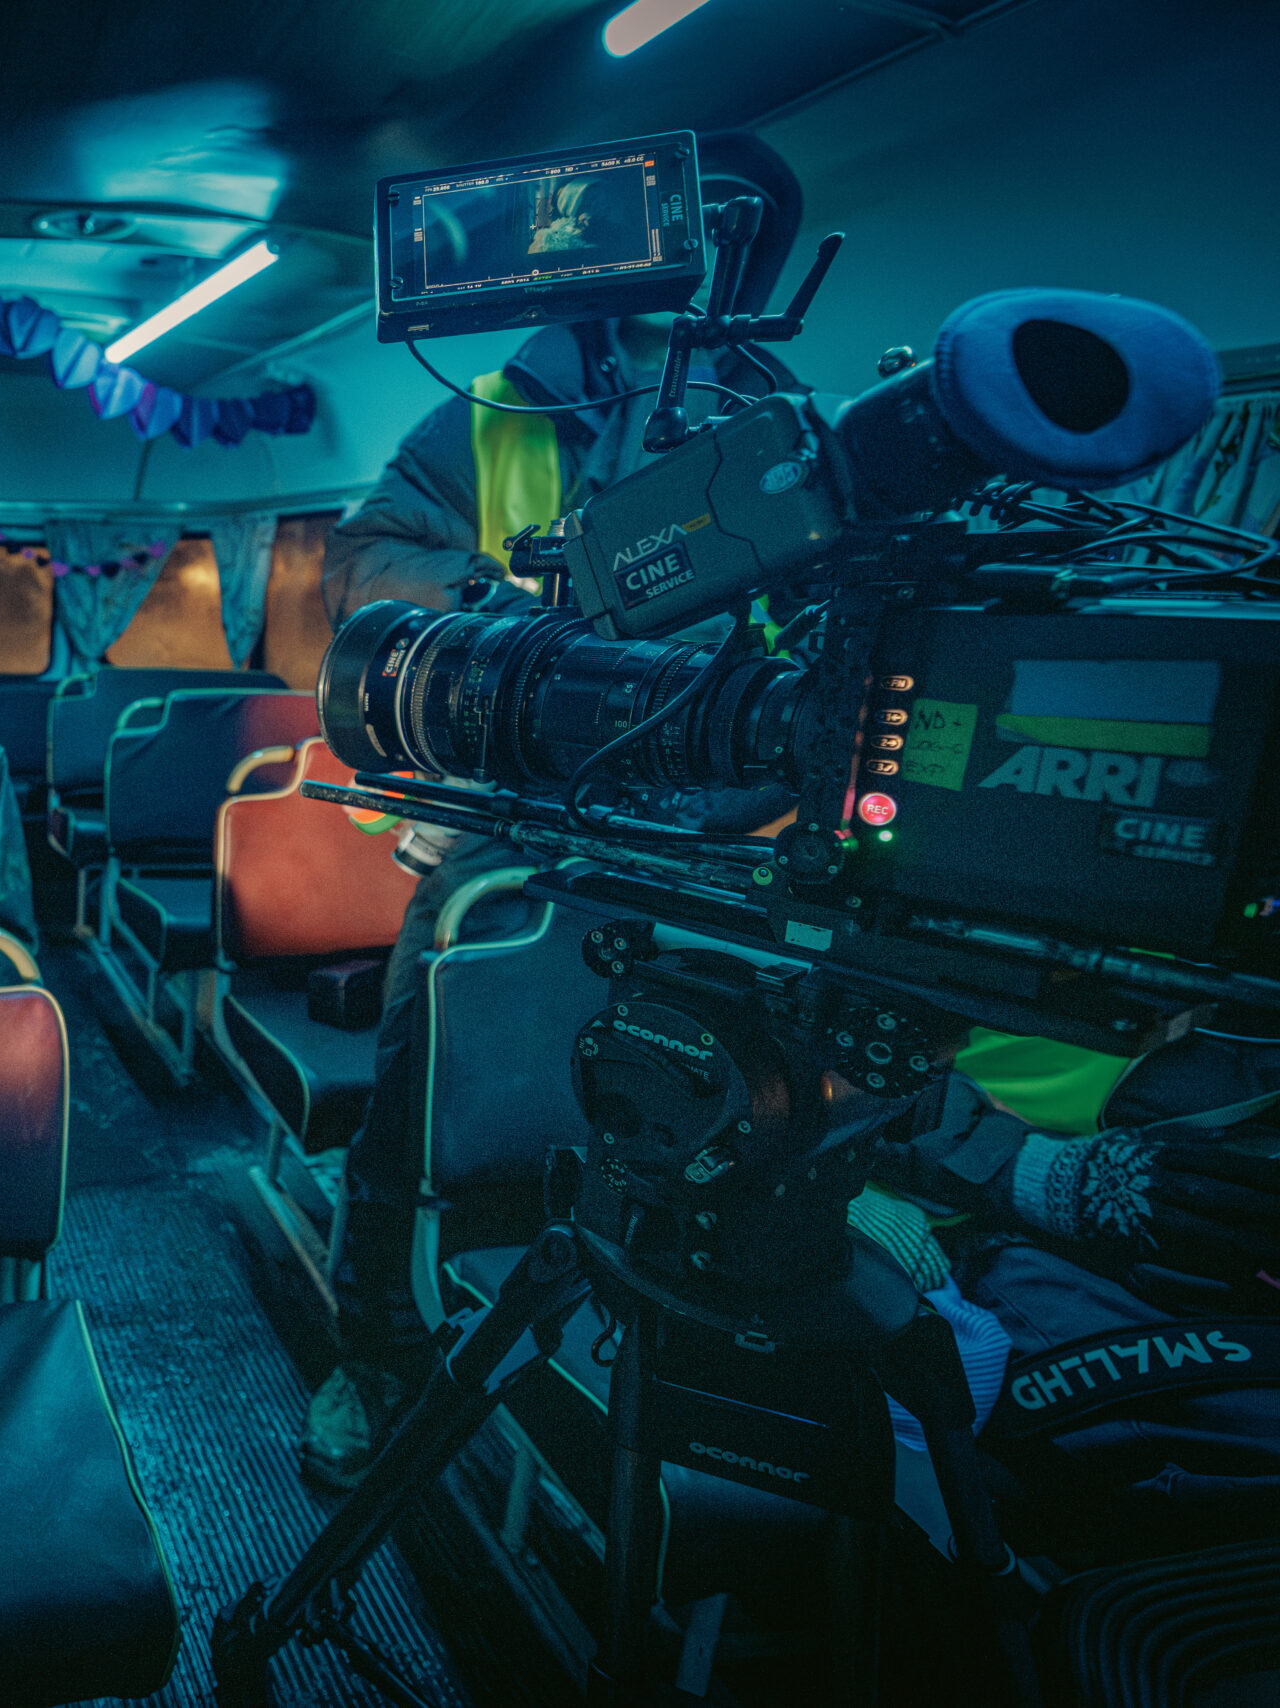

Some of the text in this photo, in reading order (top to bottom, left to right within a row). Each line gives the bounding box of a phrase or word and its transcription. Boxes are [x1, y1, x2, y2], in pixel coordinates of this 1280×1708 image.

[669, 194, 683, 222] CINE
[612, 523, 688, 572] ALEXA
[625, 553, 680, 590] CINE
[645, 569, 695, 599] SERVICE
[385, 650, 399, 674] CINE
[614, 720, 628, 728] 100
[977, 745, 1163, 807] ARRI
[866, 804, 889, 816] REC
[1114, 818, 1205, 848] CINE
[613, 1019, 713, 1061] oconnor
[689, 1441, 811, 1483] oconnor
